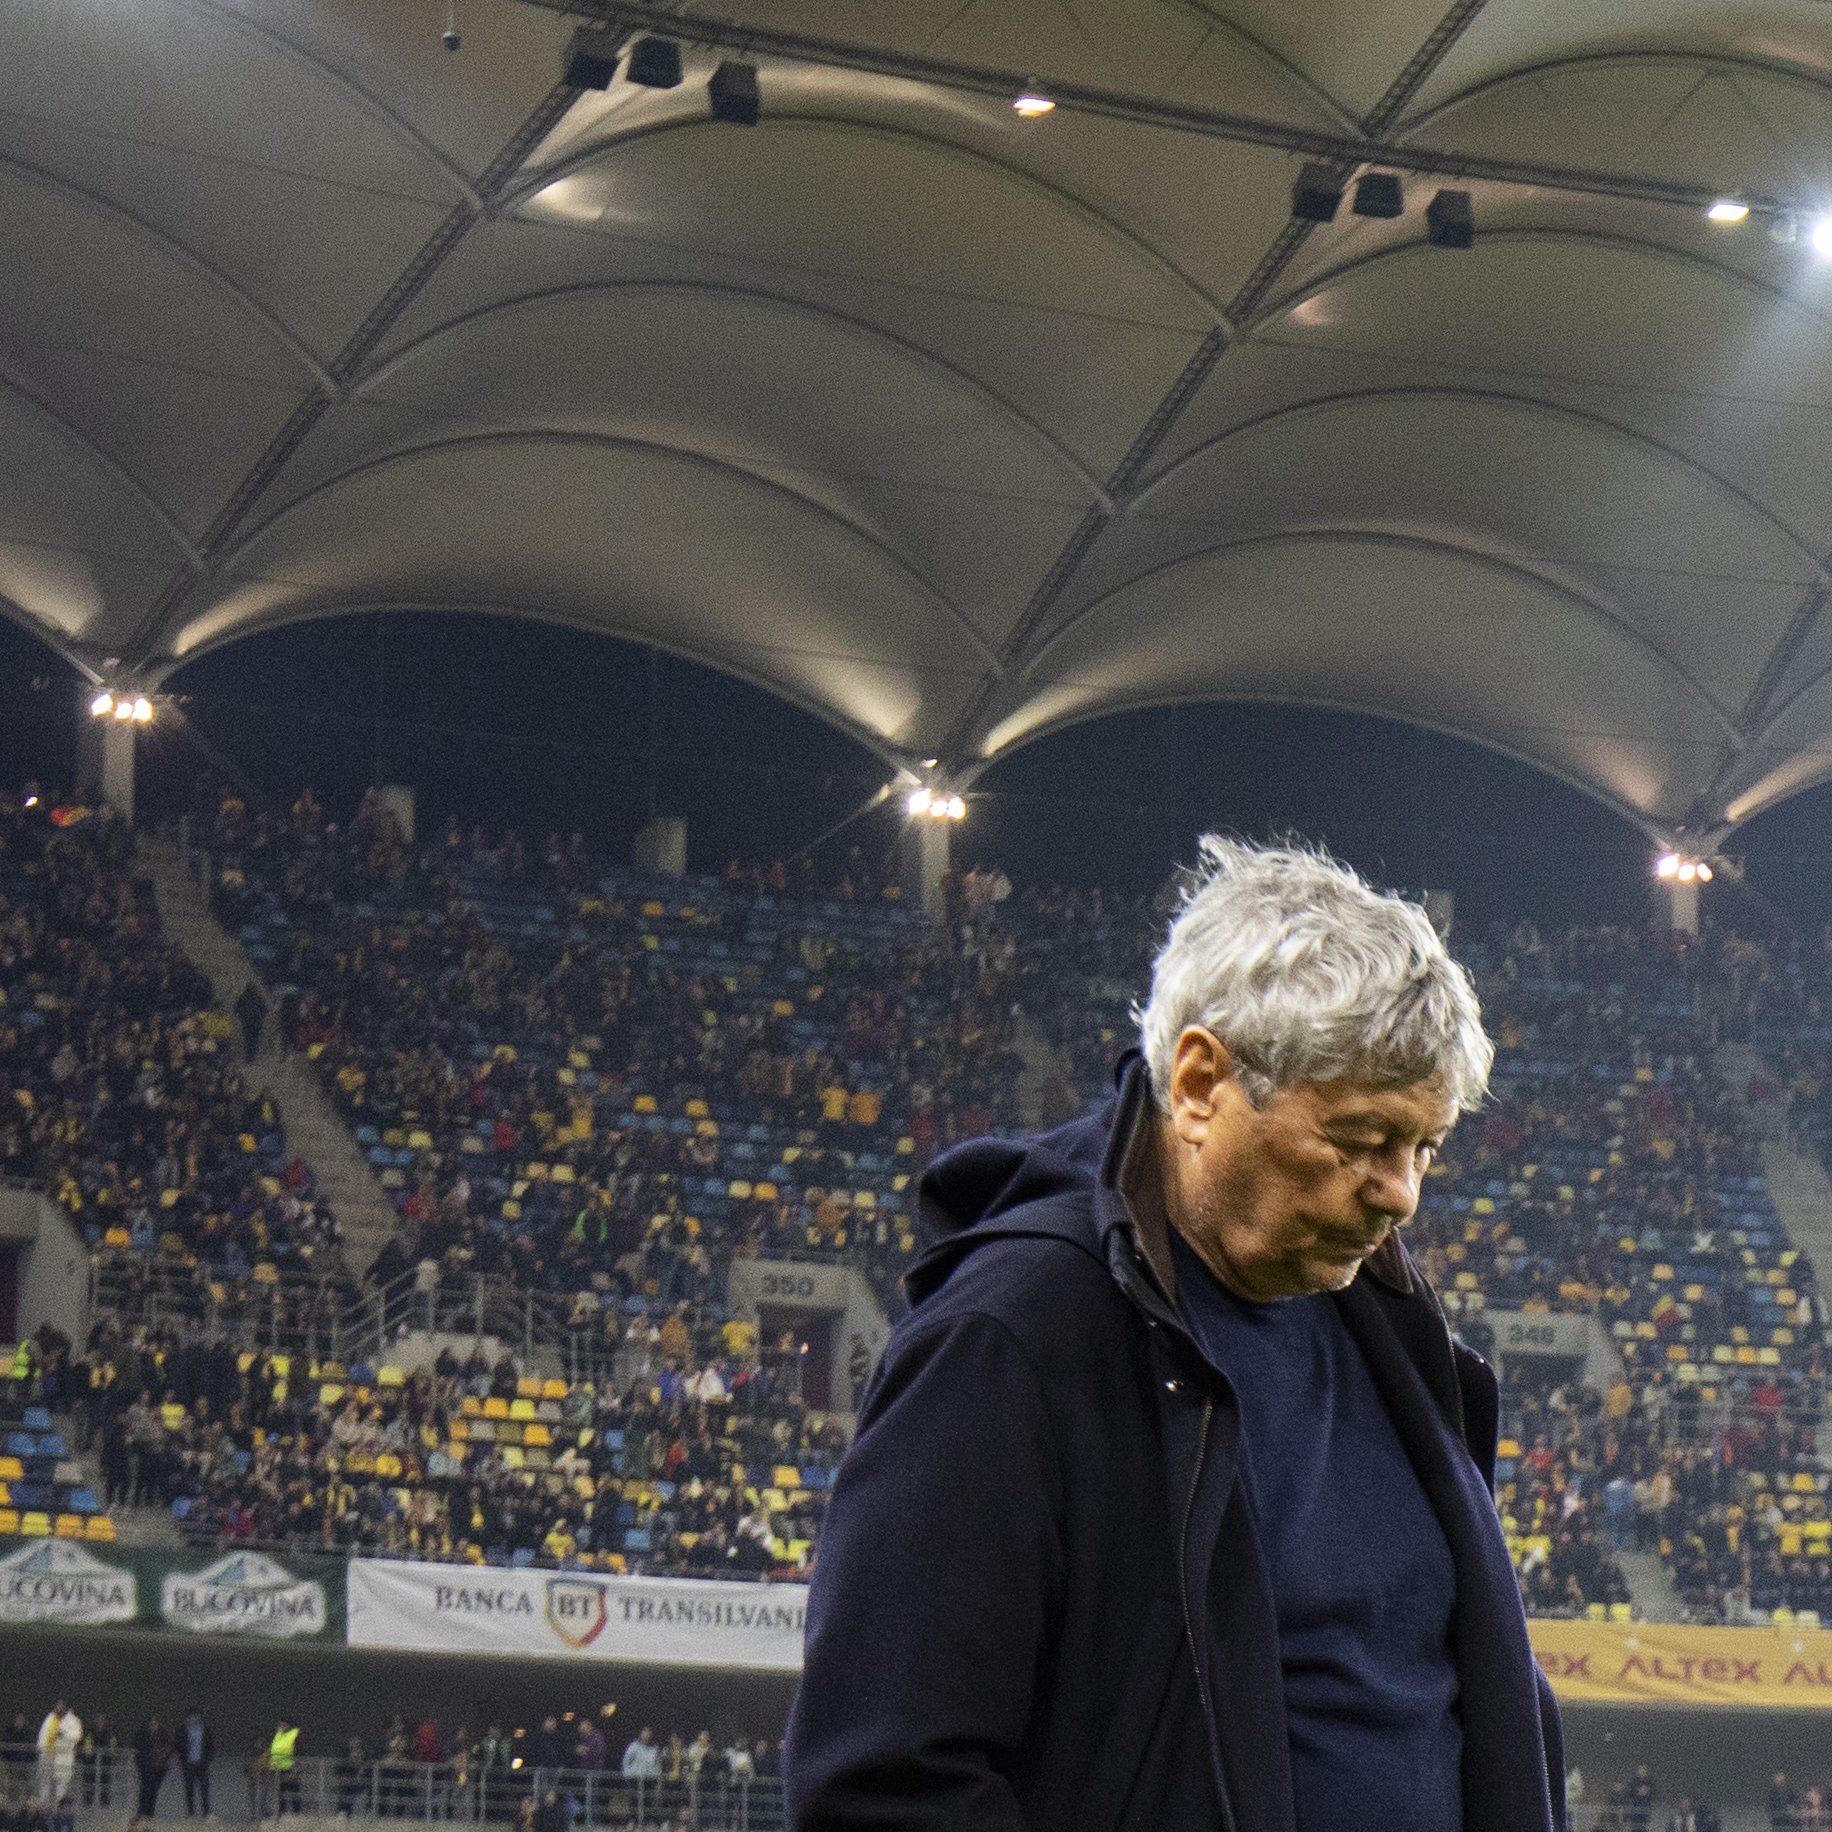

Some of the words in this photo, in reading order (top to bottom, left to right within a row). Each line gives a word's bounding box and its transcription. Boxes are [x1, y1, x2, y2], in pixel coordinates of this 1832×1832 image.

[763, 1274, 815, 1296] 350
[0, 1575, 125, 1609] UCOVINA
[172, 1586, 317, 1620] BUCOVINA
[435, 1585, 534, 1618] BANCA
[558, 1597, 592, 1619] BT
[618, 1595, 805, 1631] TRANSILVANI
